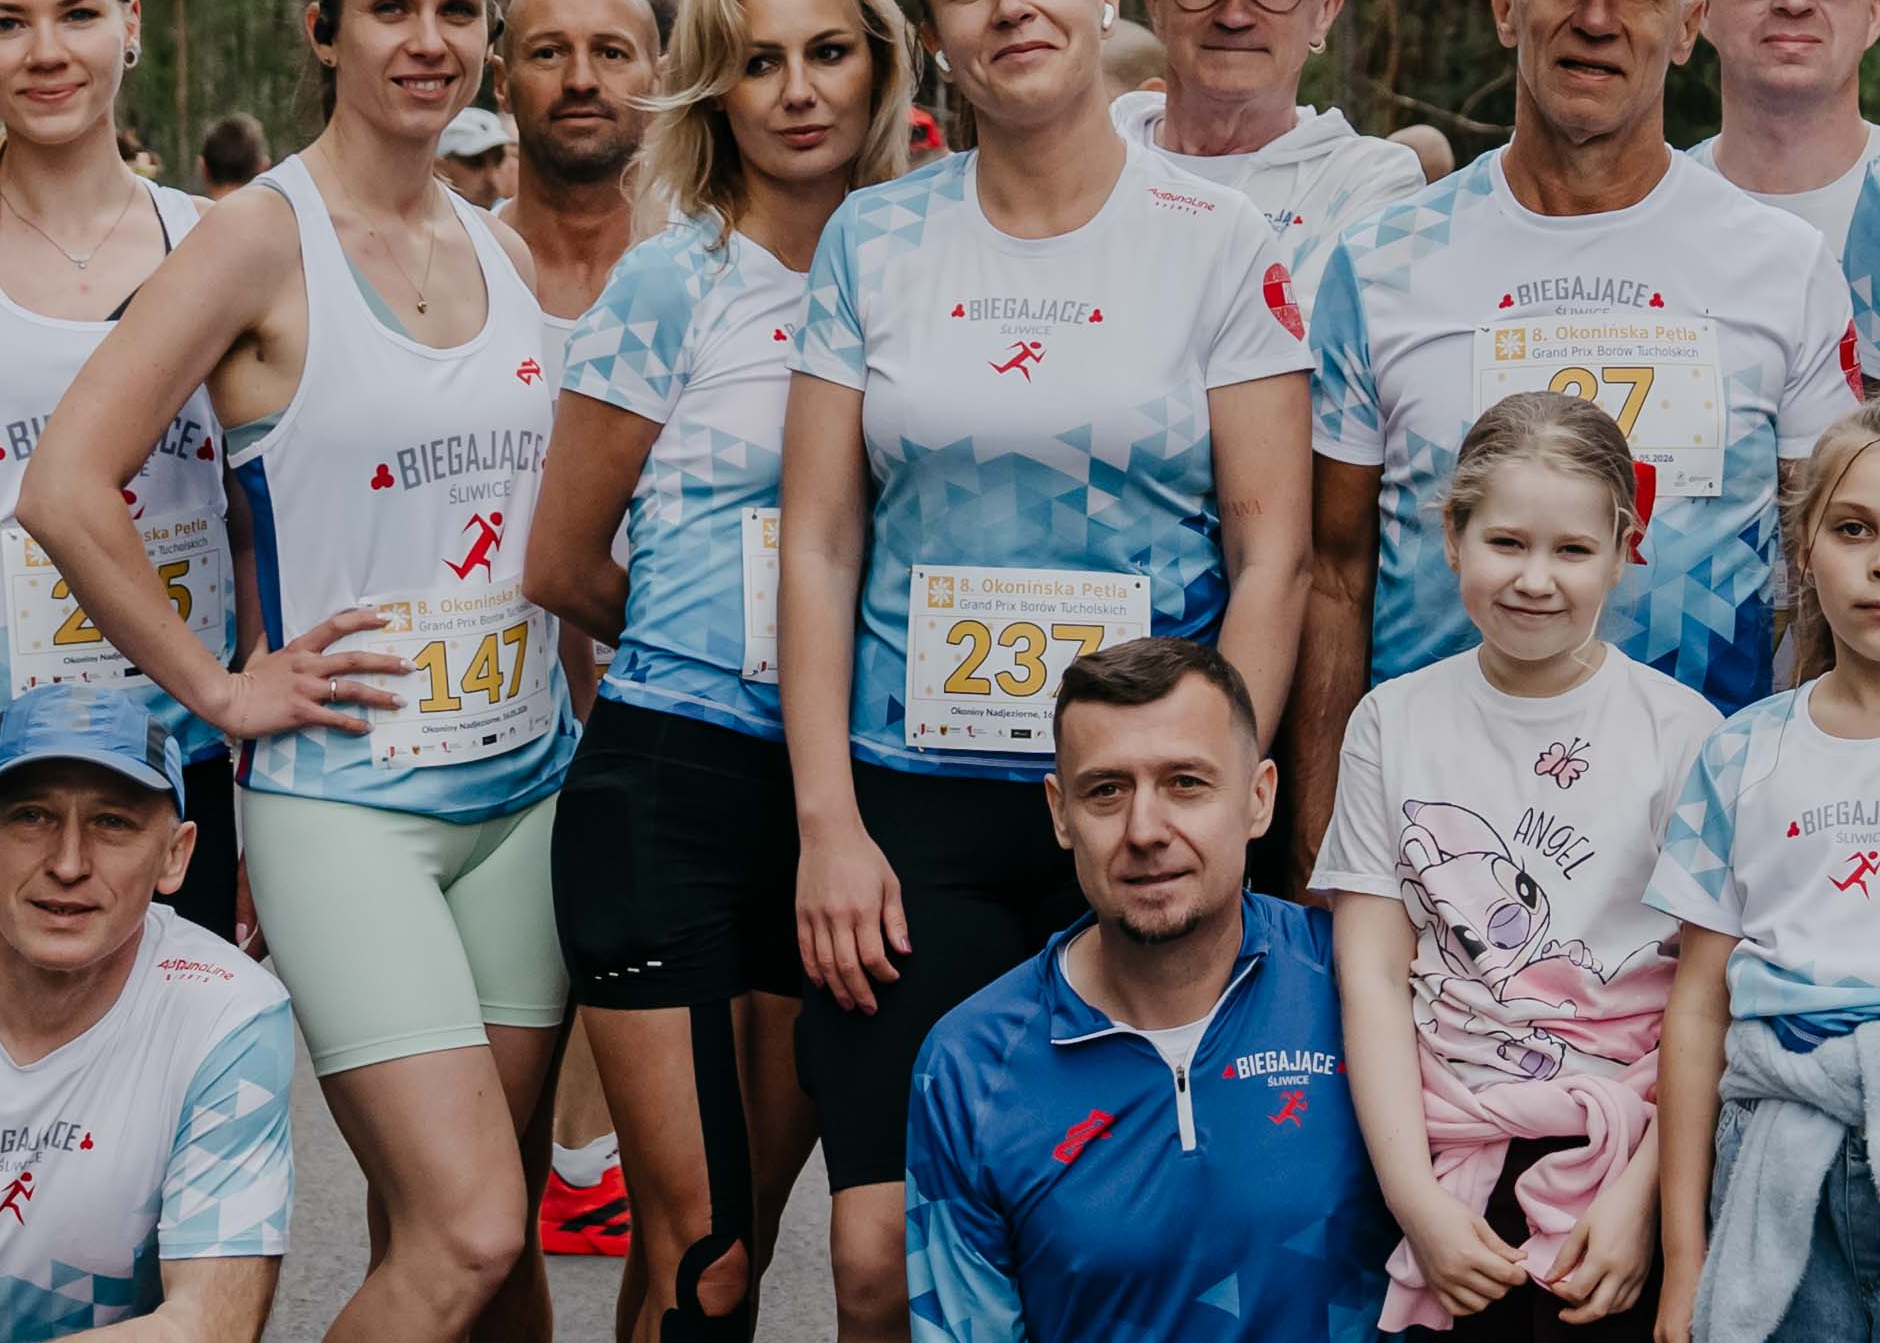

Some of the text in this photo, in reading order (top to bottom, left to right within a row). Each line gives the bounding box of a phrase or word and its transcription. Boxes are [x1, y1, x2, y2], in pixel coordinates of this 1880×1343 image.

[1517, 276, 1649, 308] BIEGAJĄCE
[970, 298, 1090, 325] BIEGAJĄCE
[1532, 327, 1548, 342] 8.
[1555, 325, 1649, 341] Okonińska
[1532, 345, 1699, 359] Grand Prix Borów Tucholskich
[396, 430, 543, 490] BIEGAJĄCE
[449, 480, 511, 504] ŚLIWICE
[959, 578, 974, 593] 8.
[982, 577, 1075, 596] Okonińska
[51, 560, 192, 645] 25
[959, 599, 1127, 615] Grand Prix Borów Tucholskich
[419, 619, 453, 632] Grand
[457, 617, 476, 629] Prix
[412, 621, 528, 713] 147
[944, 619, 1105, 698] 237
[1236, 1050, 1335, 1079] BIEGAJĄCE
[1267, 1075, 1310, 1087] ŚLIWICE
